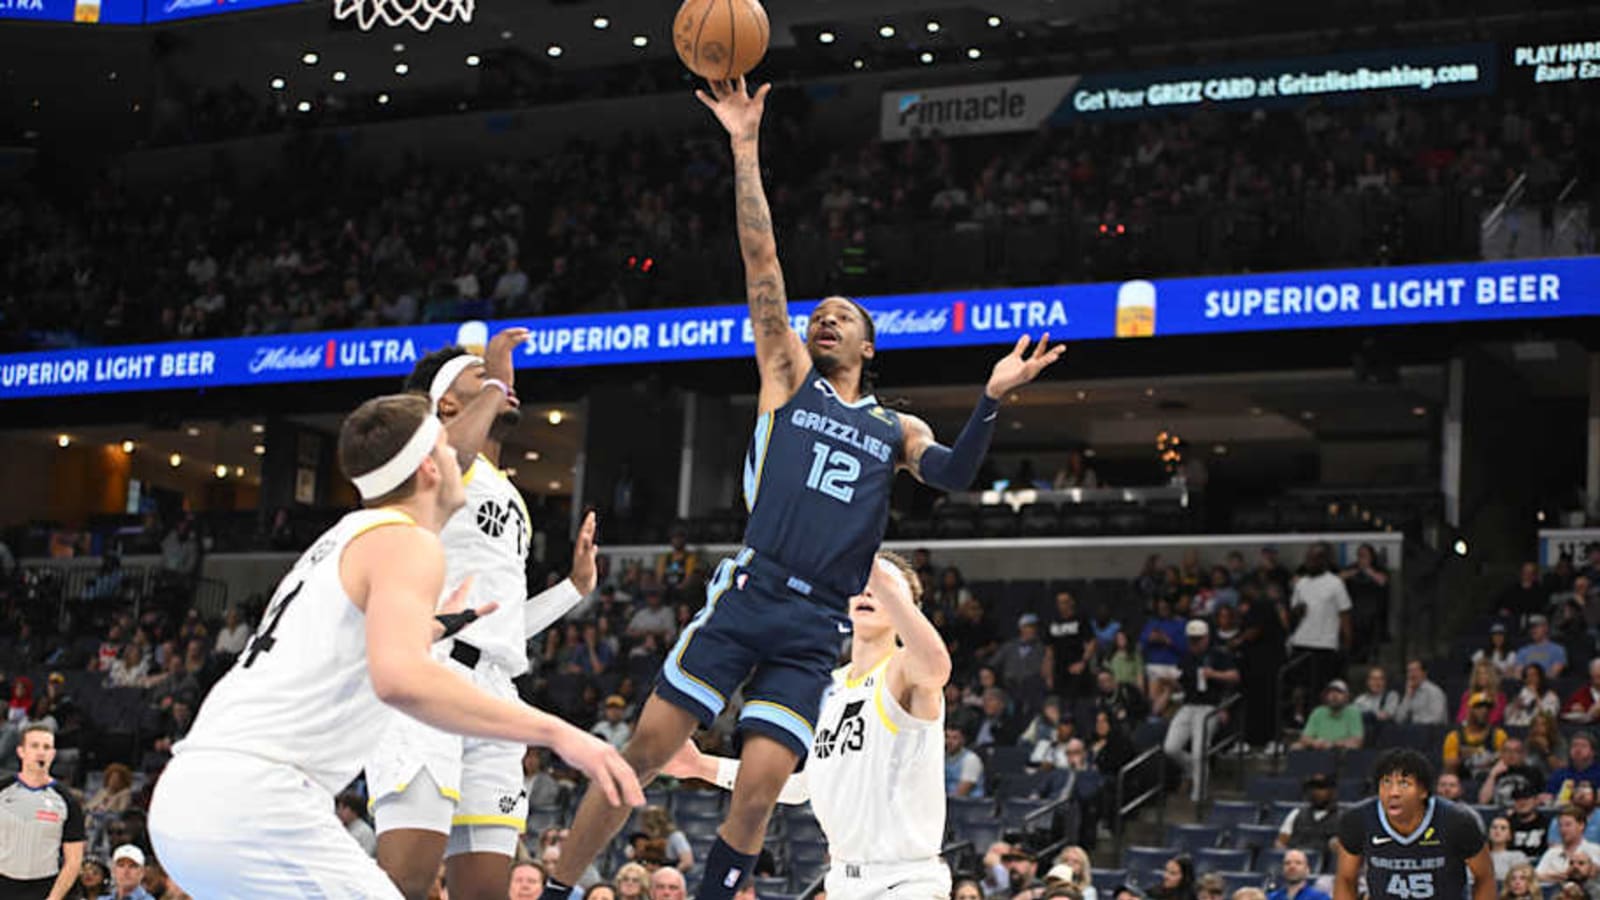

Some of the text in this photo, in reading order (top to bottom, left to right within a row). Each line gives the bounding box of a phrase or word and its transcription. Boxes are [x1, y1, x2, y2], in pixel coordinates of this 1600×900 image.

[1515, 46, 1558, 66] PLAY
[1535, 63, 1577, 83] Bank
[1074, 64, 1478, 111] Get Your GRIZZ CARD at GrizzliesBanking.com
[900, 88, 1026, 126] Pinnacle
[1205, 273, 1561, 318] SUPERIOR LIGHT BEER
[971, 300, 1068, 330] ULTRA
[340, 338, 417, 366] ULTRA
[525, 323, 650, 355] SUPERIOR
[658, 319, 736, 348] LIGHT
[0, 351, 216, 387] UPERIOR LIGHT BEER
[791, 408, 893, 463] GRIZZLIES
[806, 441, 862, 504] 12
[1386, 873, 1435, 900] 45
